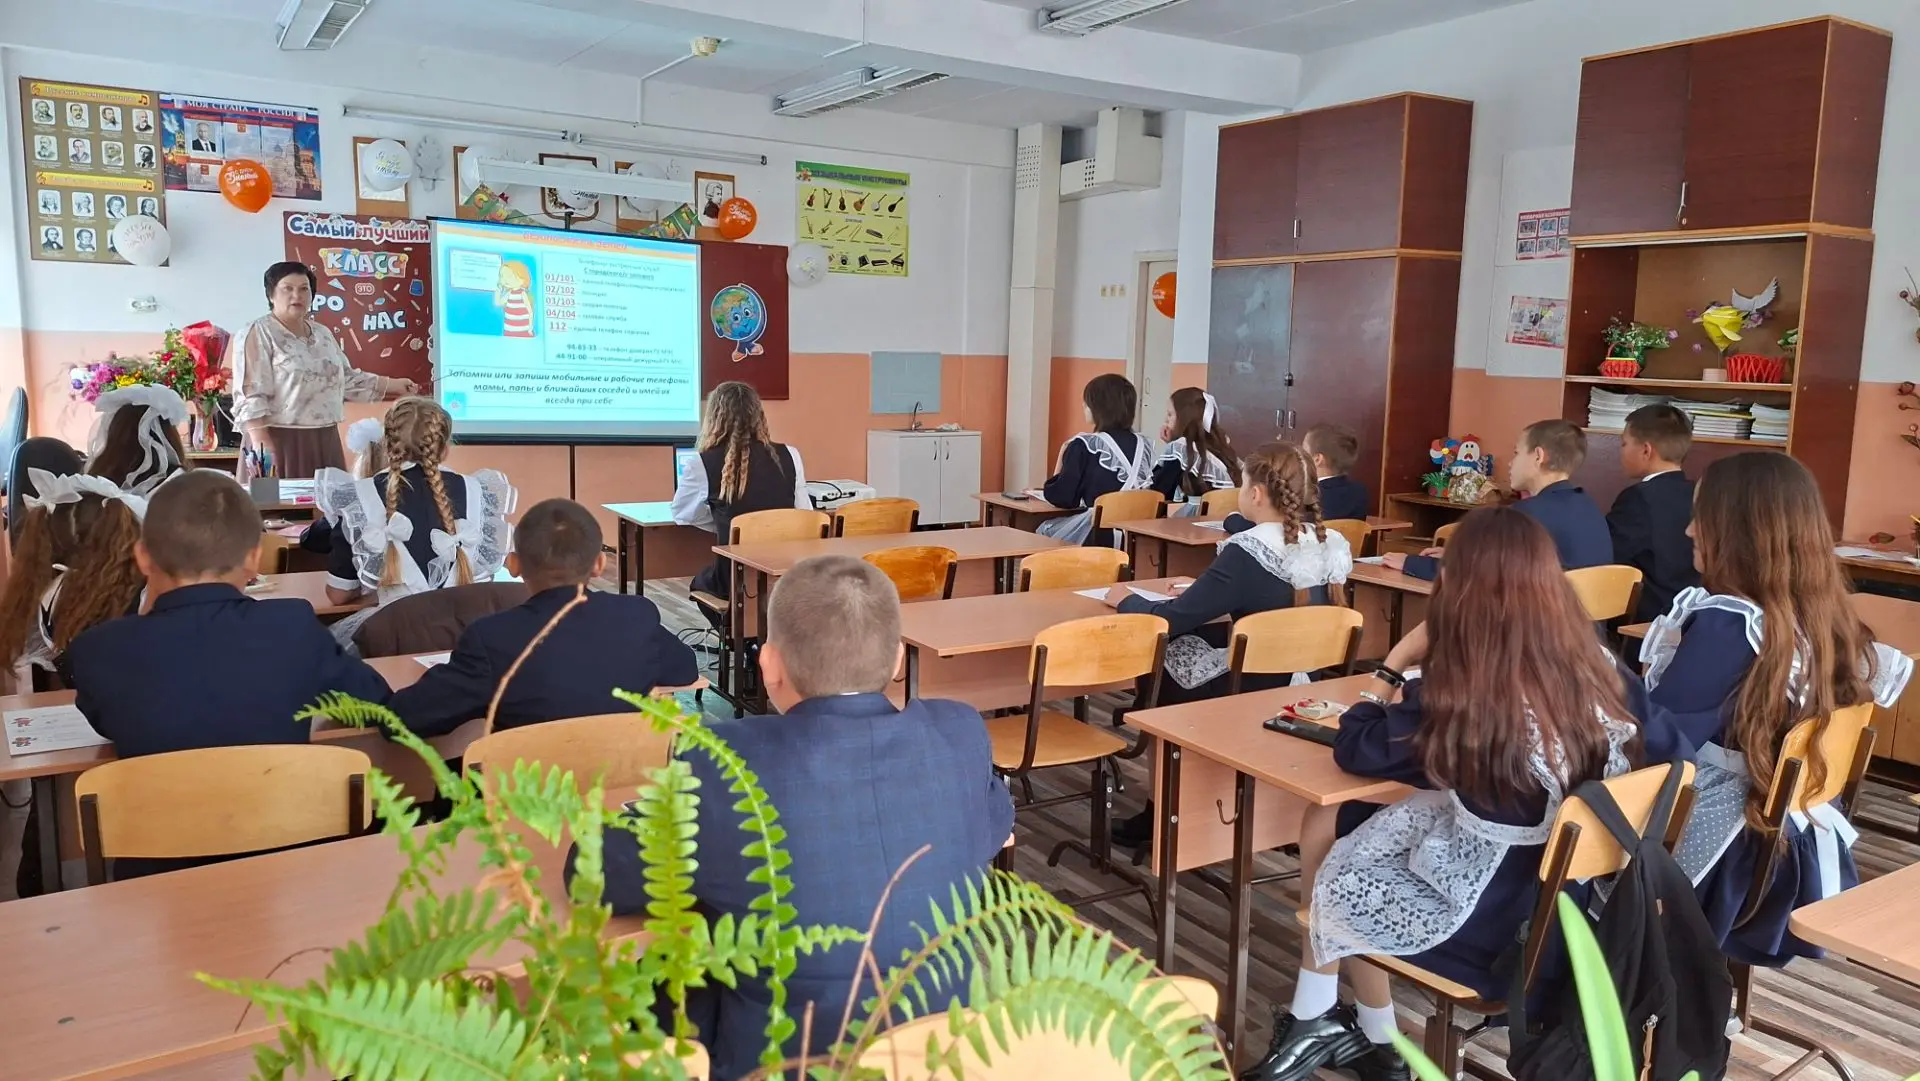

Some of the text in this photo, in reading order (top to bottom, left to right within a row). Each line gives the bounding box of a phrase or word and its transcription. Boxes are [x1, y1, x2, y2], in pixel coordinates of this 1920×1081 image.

[187, 100, 209, 109] МОЯ
[212, 103, 248, 112] СТРАНА
[258, 107, 294, 117] РОССИЯ
[289, 217, 429, 241] Самый лучший
[327, 252, 401, 273] КЛАСС
[545, 273, 575, 283] 01/101
[357, 285, 374, 294] ЭТО
[545, 285, 575, 295] 02/102
[312, 294, 345, 312] РО
[545, 297, 576, 307] 03/103
[546, 308, 576, 319] 04/104
[363, 311, 407, 331] НАС
[550, 321, 567, 331] 112
[448, 368, 493, 379] Запомни
[494, 371, 513, 380] или
[514, 372, 550, 380] запиши
[551, 372, 602, 383] мобильные
[610, 374, 644, 384] рабочие
[646, 376, 690, 386] телефоны
[473, 384, 506, 392] мамы,
[508, 384, 535, 392] папы
[543, 384, 597, 393] ближайших
[598, 386, 631, 394] соседей
[639, 387, 660, 395] имей
[545, 395, 614, 407] всегда при себе
